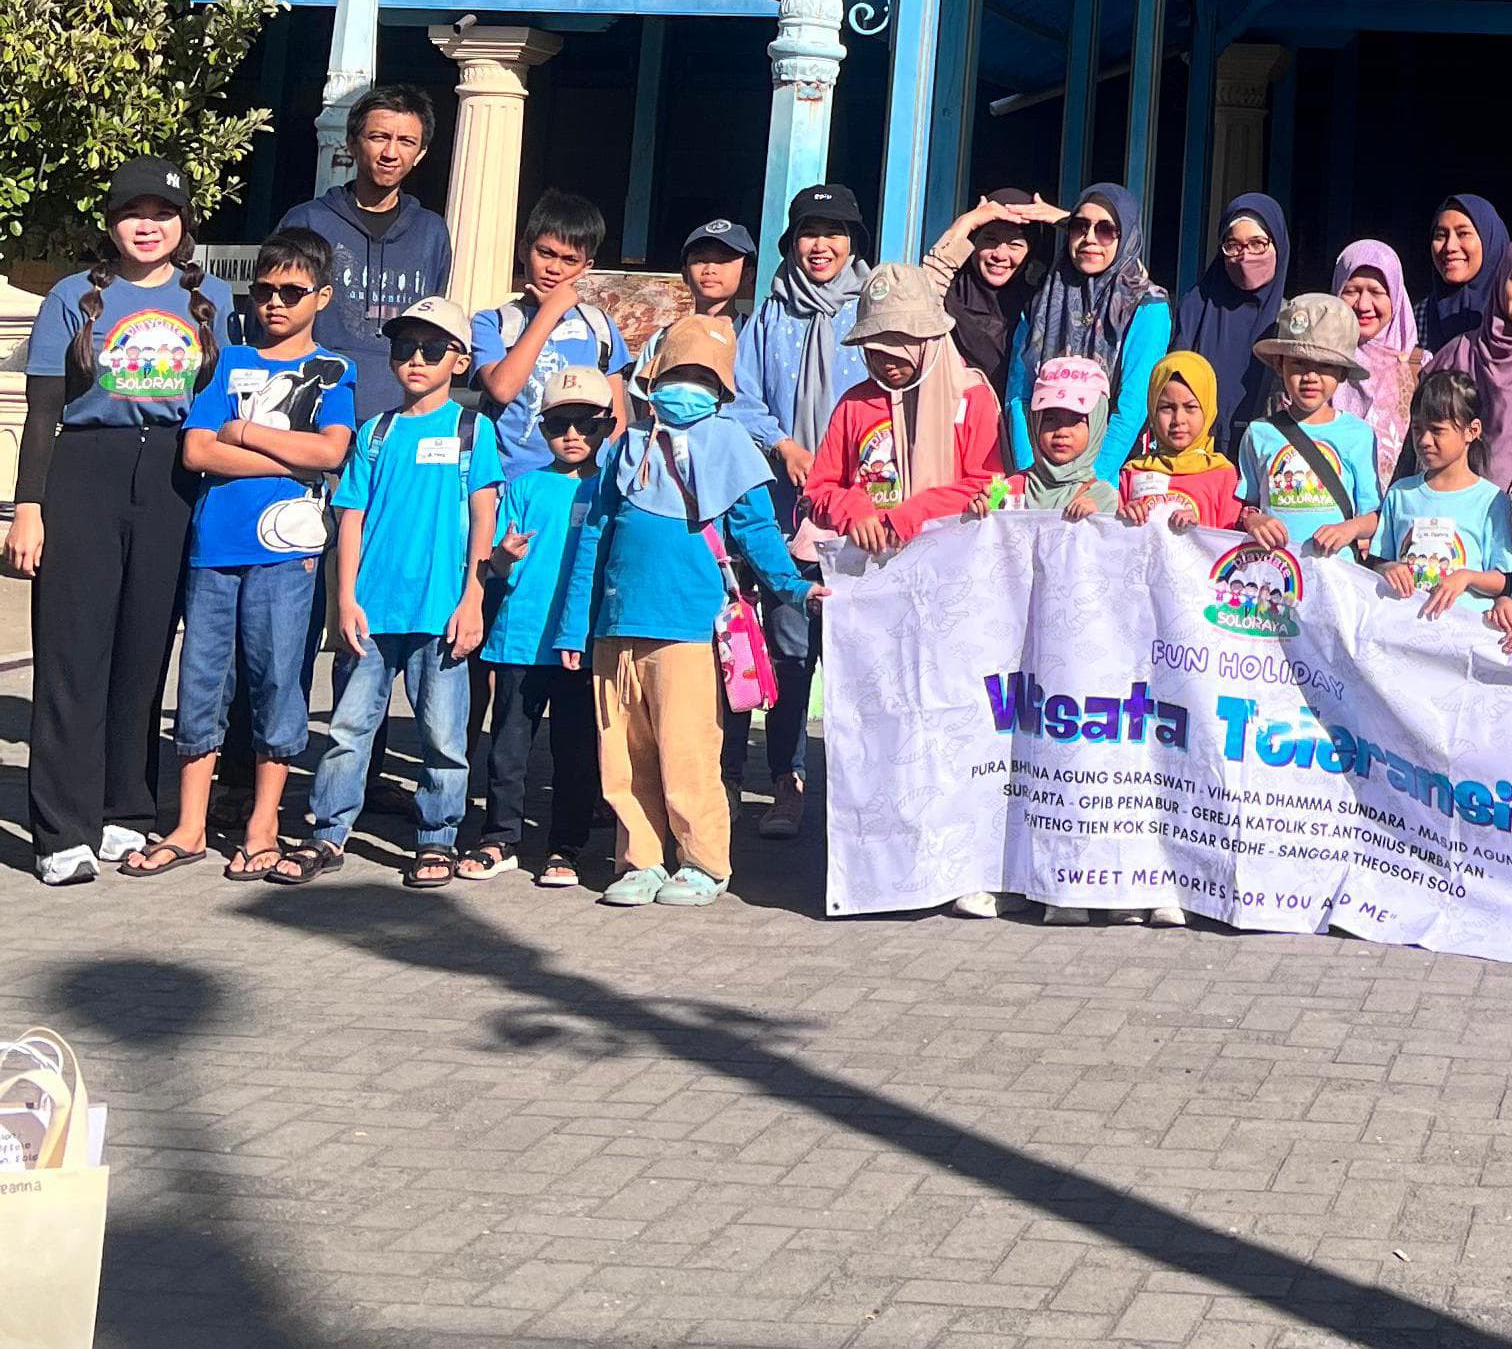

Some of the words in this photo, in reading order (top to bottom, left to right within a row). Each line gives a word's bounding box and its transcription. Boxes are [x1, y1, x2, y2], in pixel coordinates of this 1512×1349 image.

[210, 258, 240, 281] KAMAR
[1217, 611, 1290, 636] SOLORAYA
[1151, 639, 1209, 673] FUN
[1219, 651, 1345, 701] HOLIDAY
[984, 670, 1188, 752] Wisata
[971, 760, 1007, 778] PURA
[1053, 770, 1109, 784] AGUNG
[1112, 771, 1196, 794] SARASWATI
[1207, 785, 1261, 805] VIHARA
[1266, 793, 1333, 812] DHAMMA
[1337, 801, 1406, 830] SUNDARA
[1418, 824, 1468, 853] MASJID
[1079, 796, 1113, 809] GPIB
[1117, 796, 1179, 815] PENABUR
[1191, 806, 1241, 828] GEREJA
[1246, 817, 1307, 835] KATOLIK
[1409, 844, 1484, 879] PURBAYAN
[1077, 820, 1109, 834] TIEN
[1114, 820, 1144, 834] KOK
[1148, 820, 1169, 836] SIE
[1172, 824, 1216, 847] PASAR
[1220, 837, 1266, 856] GEDHE
[1278, 845, 1349, 862] SANGGAR
[1353, 851, 1425, 886] THEOSOFI
[1427, 876, 1466, 898] SOLO
[1132, 869, 1226, 899] MEMORIES
[1232, 890, 1265, 907] FOR
[1275, 892, 1312, 909] YOU
[0, 1181, 42, 1195] eanna
